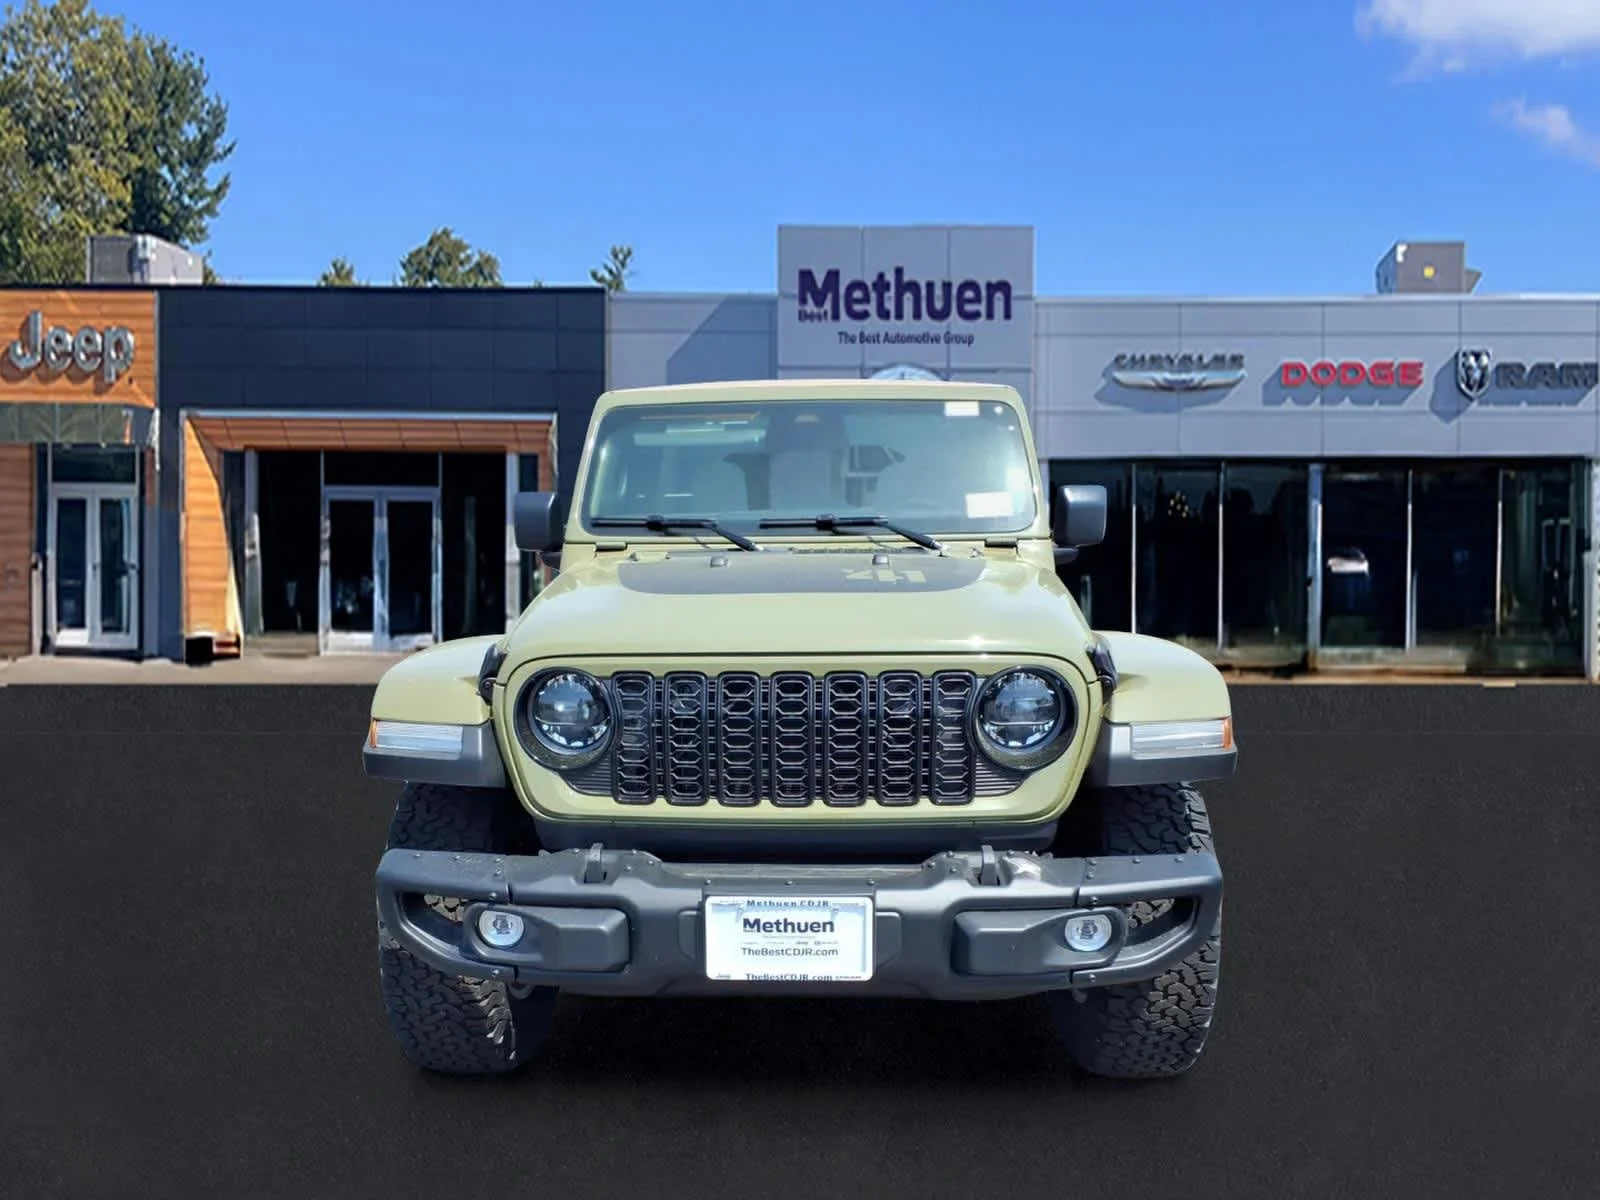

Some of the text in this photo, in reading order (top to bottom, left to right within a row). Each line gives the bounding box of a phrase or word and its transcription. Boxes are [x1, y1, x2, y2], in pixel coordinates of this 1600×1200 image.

[798, 266, 1012, 321] Methuen
[10, 310, 135, 384] Jeep
[838, 331, 974, 346] The Best Automotive Group
[1114, 353, 1245, 369] CHRYSLER
[1281, 361, 1424, 386] DODGE
[1495, 362, 1599, 388] RAM
[742, 917, 835, 933] Methuen
[742, 947, 839, 957] TheBestCDJR.com
